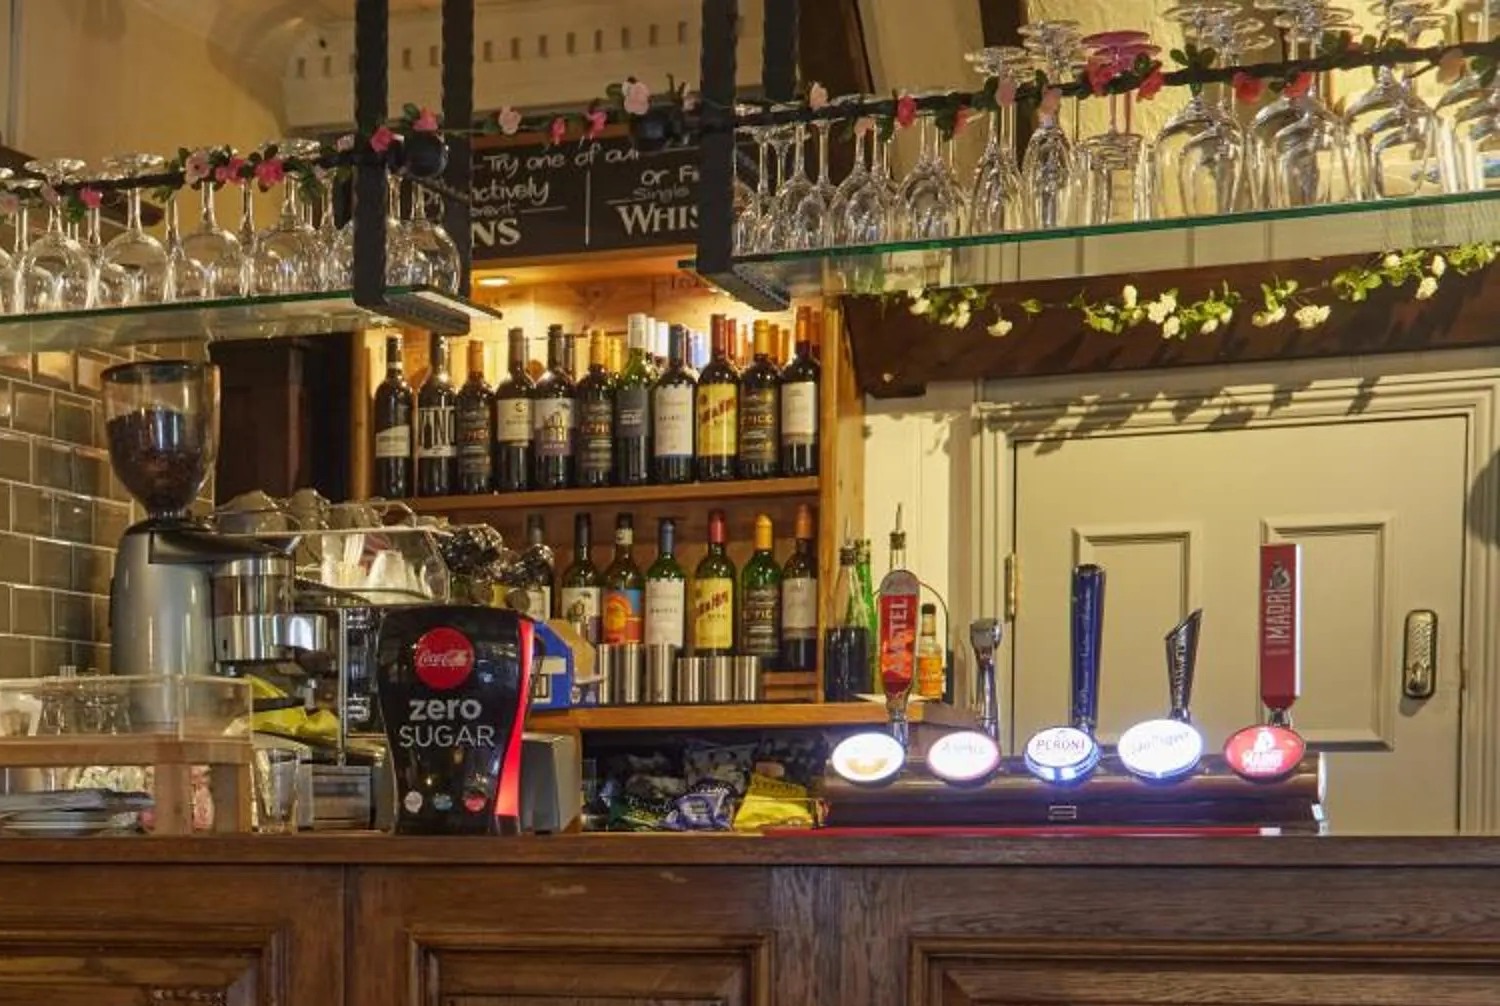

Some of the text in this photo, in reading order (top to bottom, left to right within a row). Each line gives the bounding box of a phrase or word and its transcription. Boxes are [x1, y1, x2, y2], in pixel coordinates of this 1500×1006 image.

[483, 153, 520, 178] Try
[526, 153, 565, 170] one
[574, 141, 602, 167] of
[640, 168, 670, 186] or
[409, 698, 482, 721] zero
[399, 725, 495, 748] SUGAR
[1036, 737, 1085, 753] PERONI
